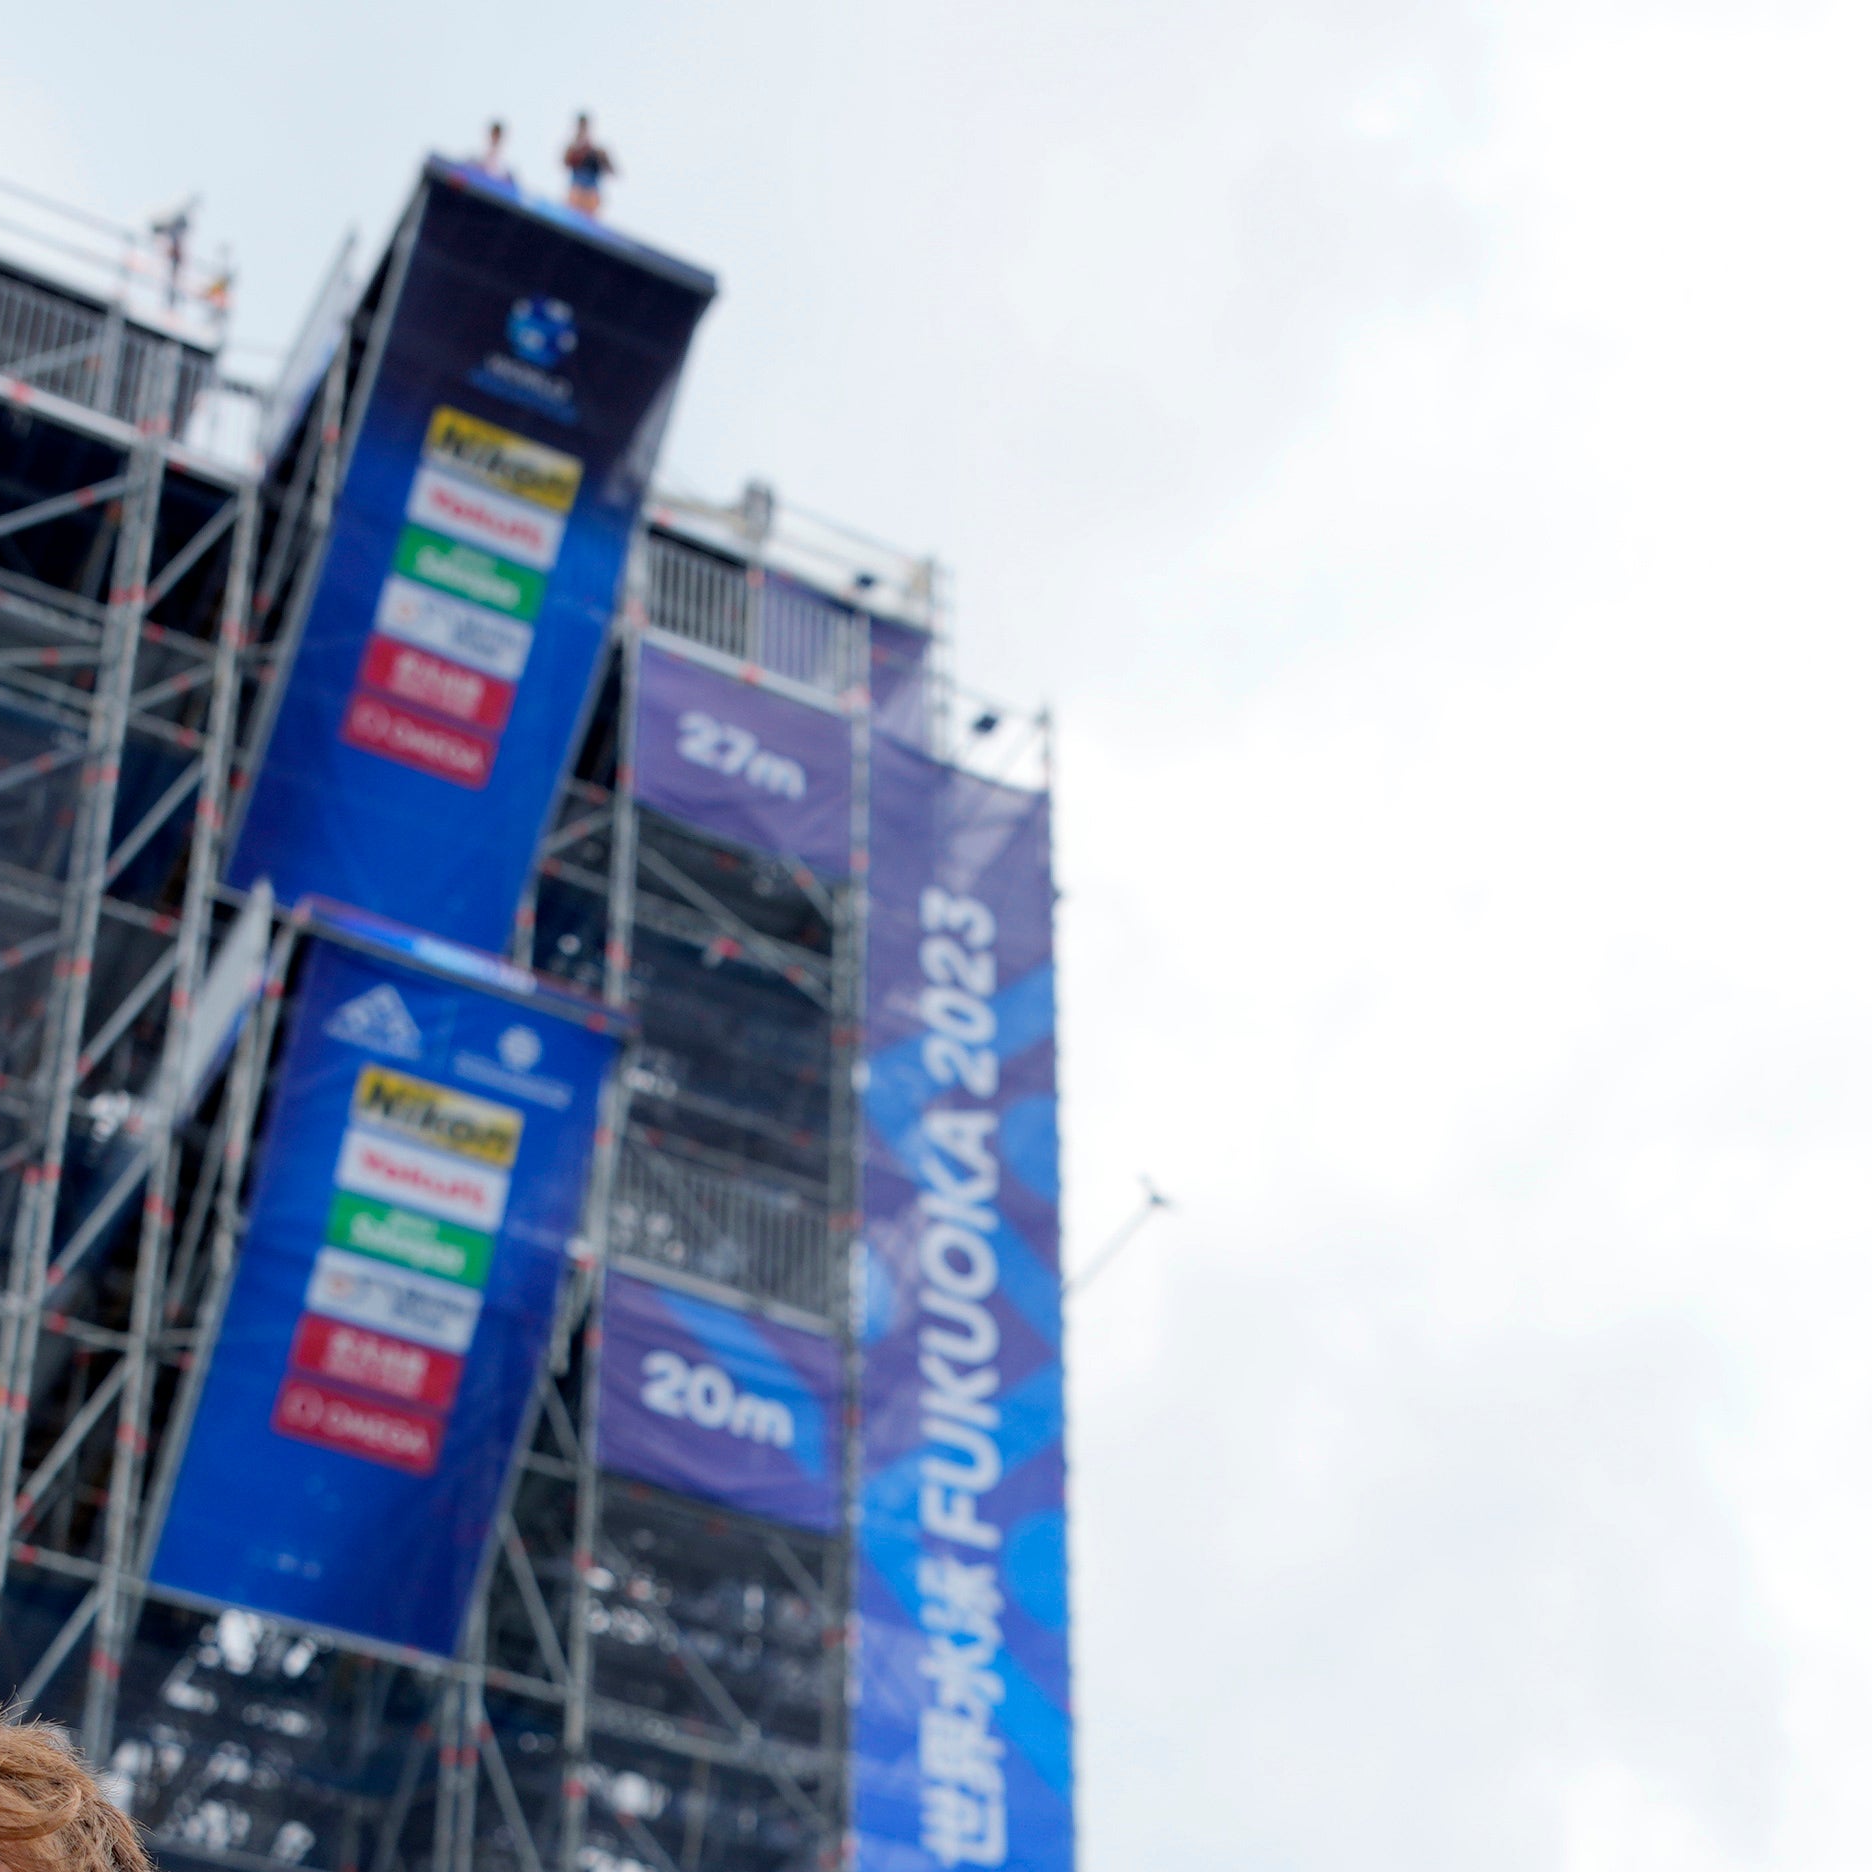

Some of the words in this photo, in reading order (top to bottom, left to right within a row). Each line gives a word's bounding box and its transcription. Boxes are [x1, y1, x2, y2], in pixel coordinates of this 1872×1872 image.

[675, 710, 807, 800] 27m
[919, 887, 998, 1098] 2023
[366, 1081, 515, 1156] Nikon
[917, 1109, 1004, 1551] FUKUOKA
[639, 1350, 795, 1449] 20m
